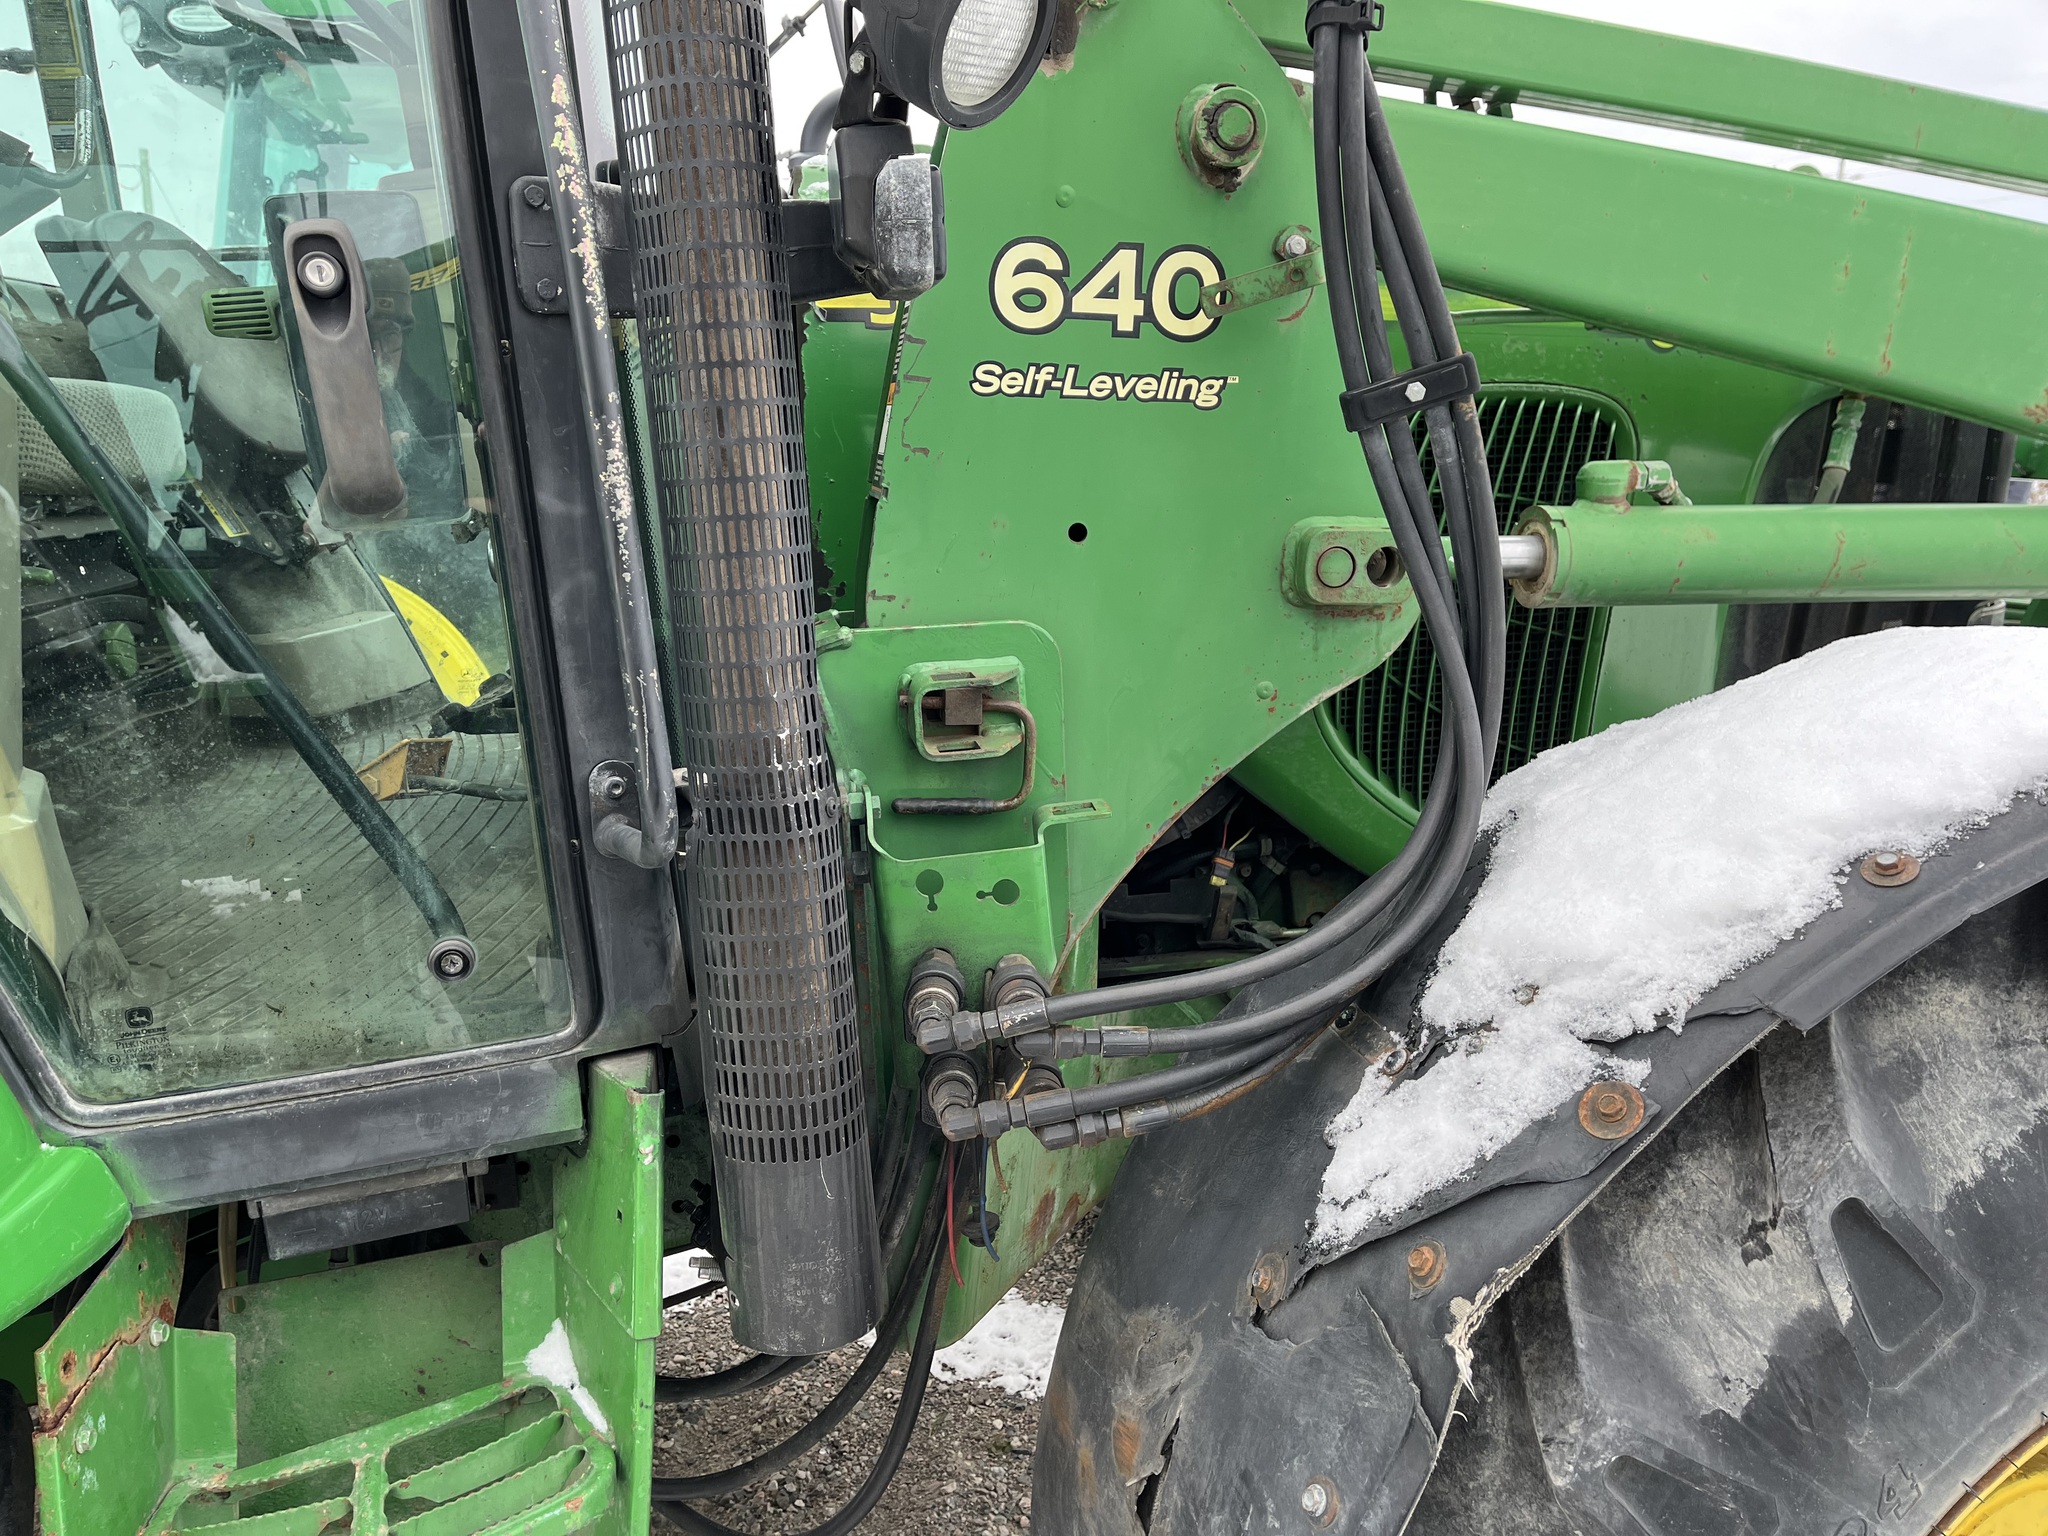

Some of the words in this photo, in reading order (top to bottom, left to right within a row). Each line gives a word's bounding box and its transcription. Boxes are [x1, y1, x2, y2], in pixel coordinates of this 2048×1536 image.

[989, 236, 1226, 342] 640
[970, 361, 1226, 410] Self-Leveling
[116, 1036, 170, 1049] PILKINGTON
[121, 1031, 141, 1039] JOHN
[351, 1206, 388, 1232] 12V
